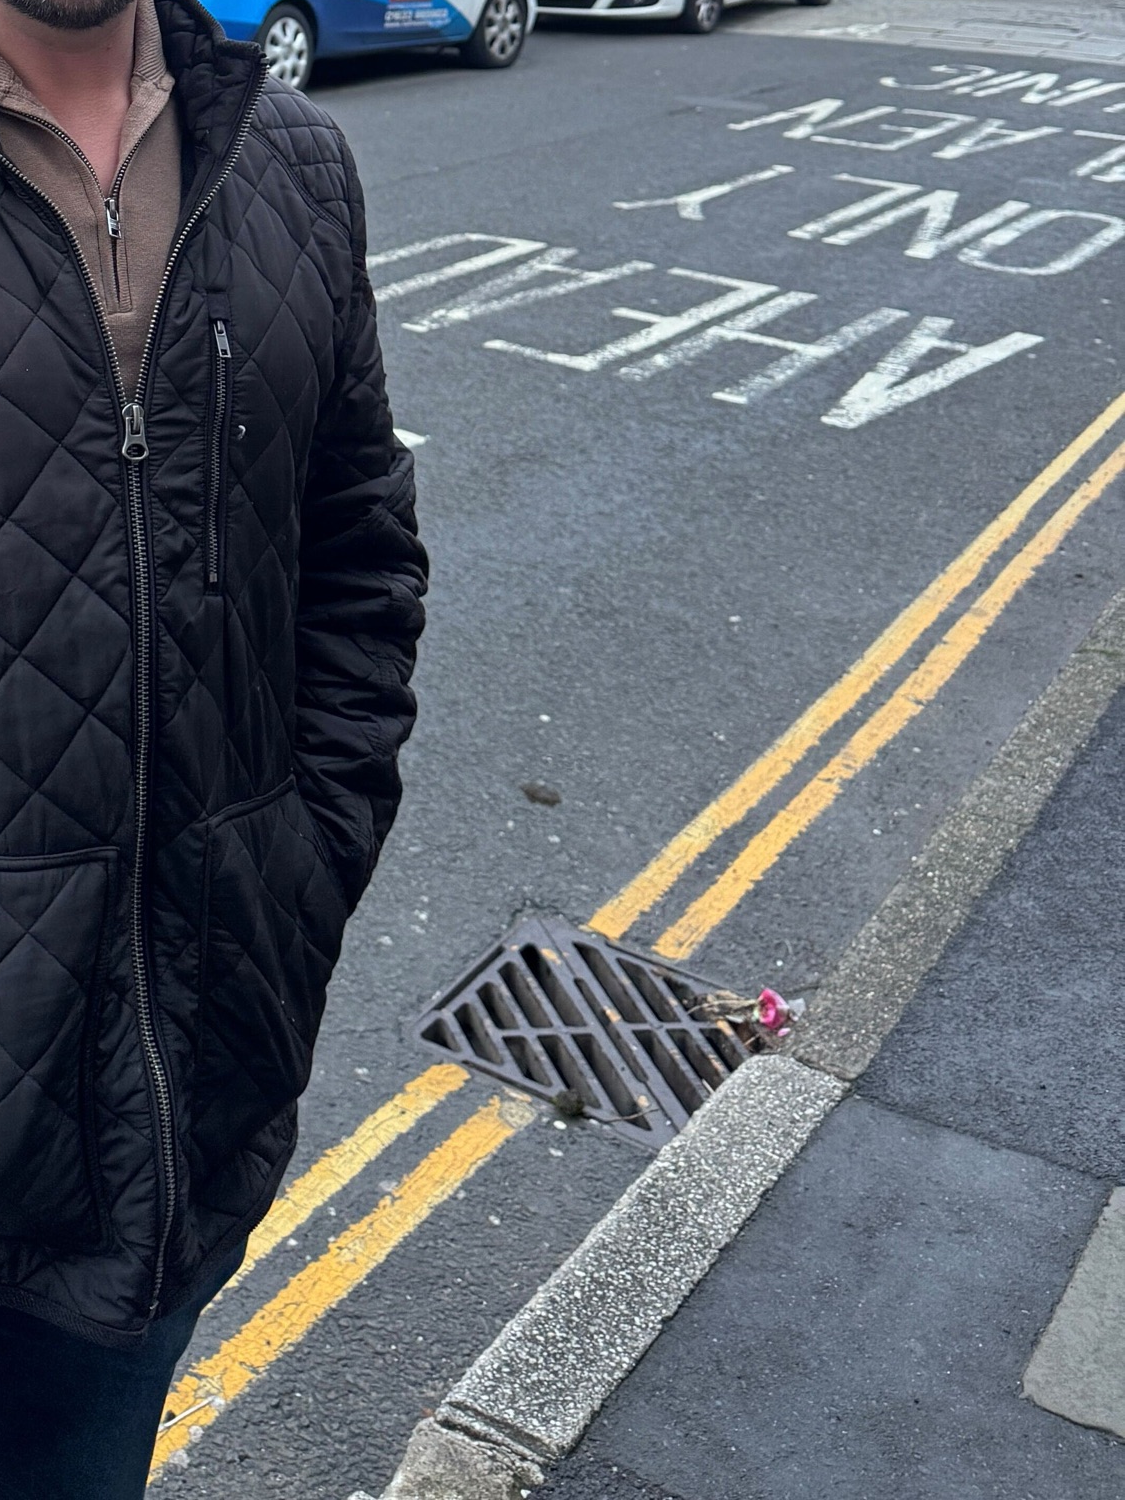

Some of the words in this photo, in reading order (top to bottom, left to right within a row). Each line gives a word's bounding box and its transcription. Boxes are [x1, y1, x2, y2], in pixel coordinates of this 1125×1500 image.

[727, 98, 1125, 183] LAEN
[612, 165, 1125, 276] ONLY
[365, 232, 1044, 430] AHEAD
